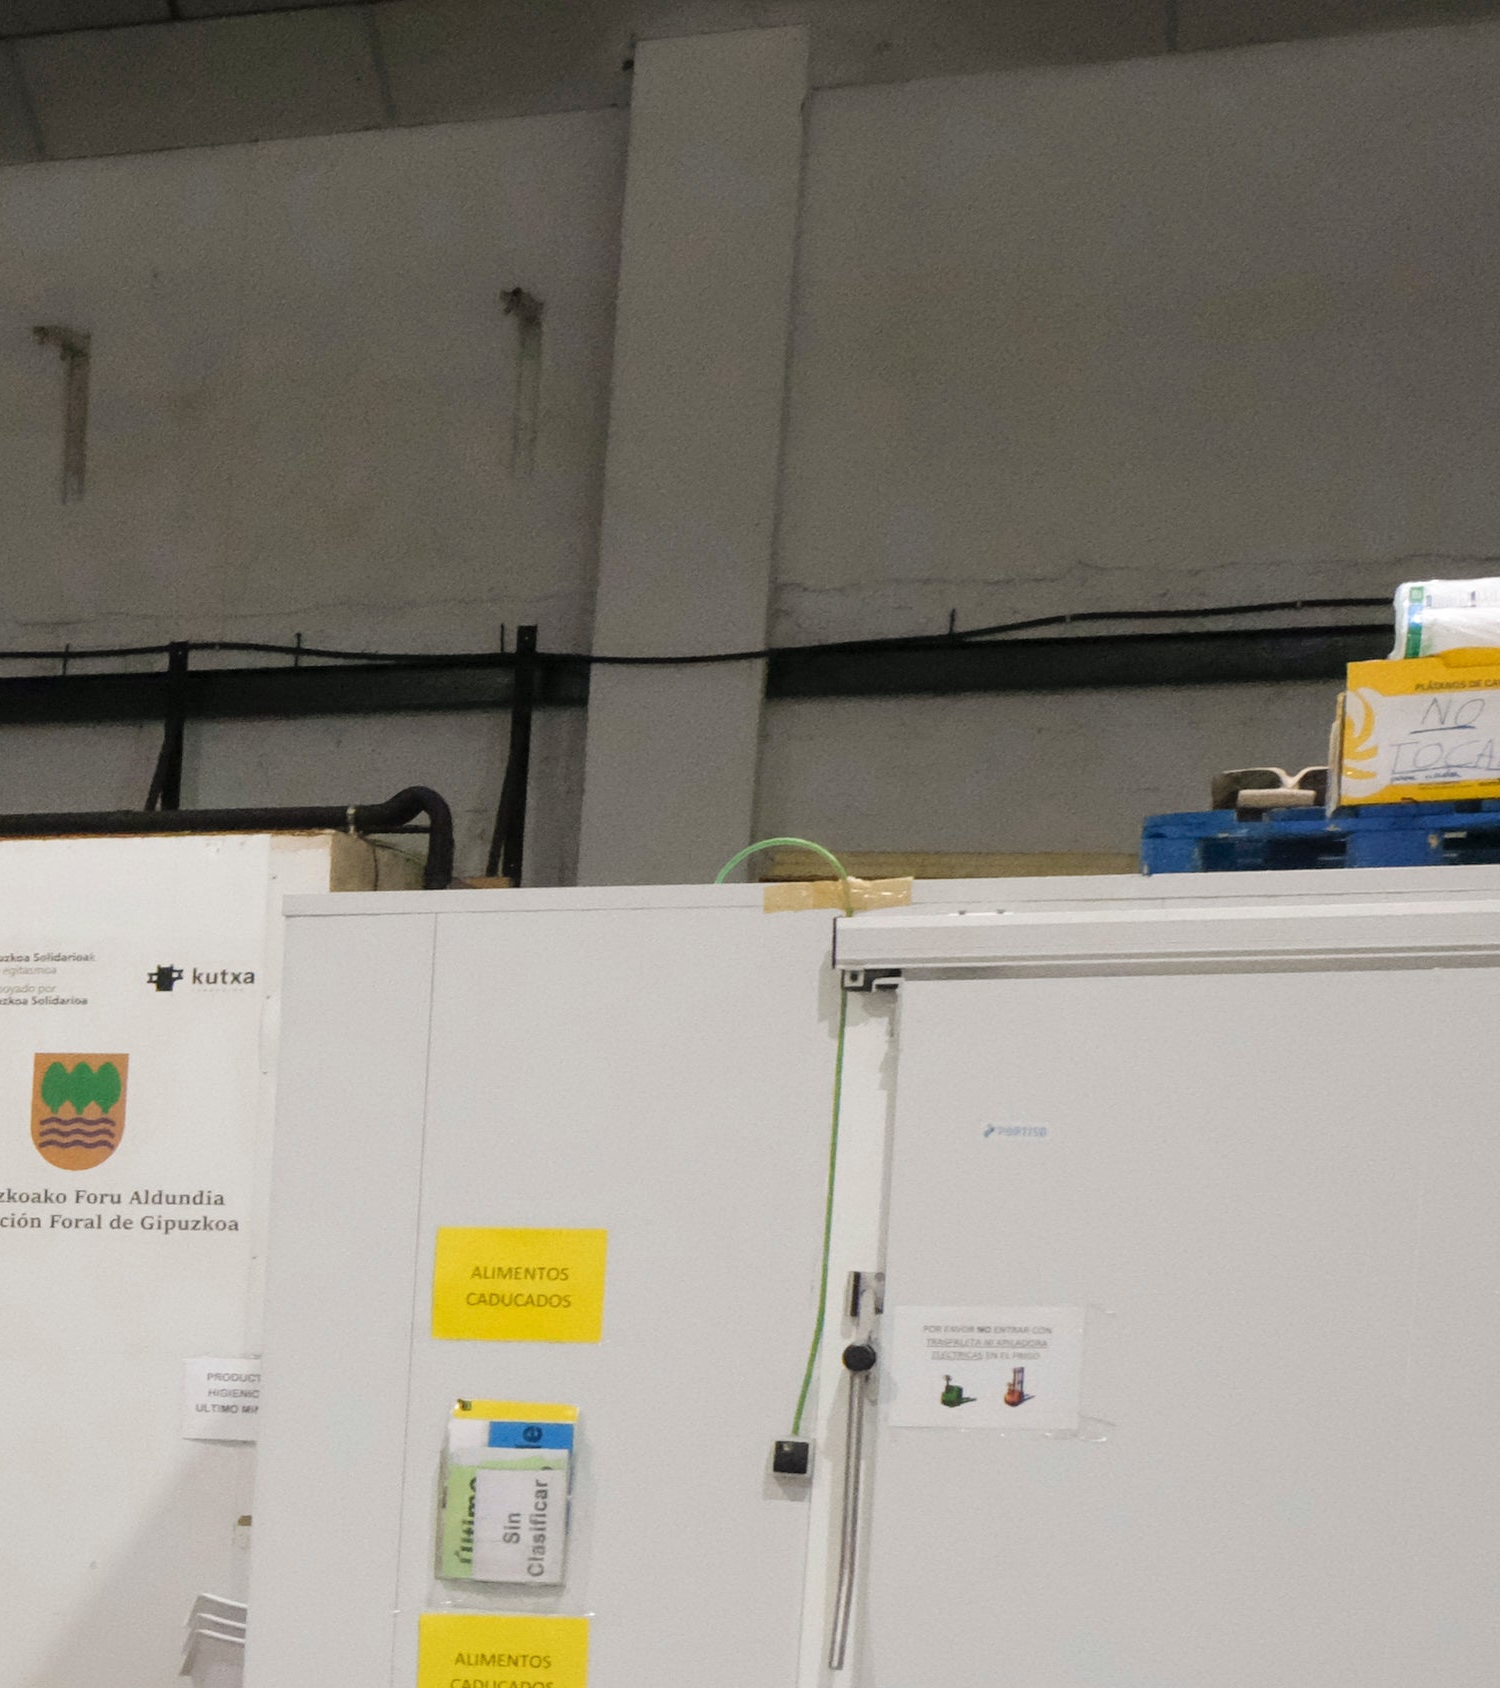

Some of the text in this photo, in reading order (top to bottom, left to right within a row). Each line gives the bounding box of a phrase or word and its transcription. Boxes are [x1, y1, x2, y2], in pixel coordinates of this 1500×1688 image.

[1421, 697, 1486, 726] NO
[33, 952, 96, 963] Solidarioak
[192, 967, 255, 985] kutxa
[38, 986, 57, 997] por
[31, 996, 88, 1006] Solidarioa
[74, 1189, 122, 1205] Foru
[129, 1190, 225, 1206] Aldundia
[49, 1214, 102, 1230] Foral
[109, 1215, 133, 1230] de
[140, 1215, 240, 1235] Gipuzkoa
[470, 1266, 569, 1281] ALIMENTOS
[466, 1292, 572, 1308] CADUCADOS
[923, 1325, 943, 1333] POR
[977, 1326, 991, 1334] NO
[994, 1326, 1030, 1334] ENTRAR
[1032, 1326, 1052, 1334] CON
[502, 1512, 522, 1545] Sin
[527, 1478, 549, 1578] Clasificar
[454, 1652, 552, 1669] ALIMENTOS
